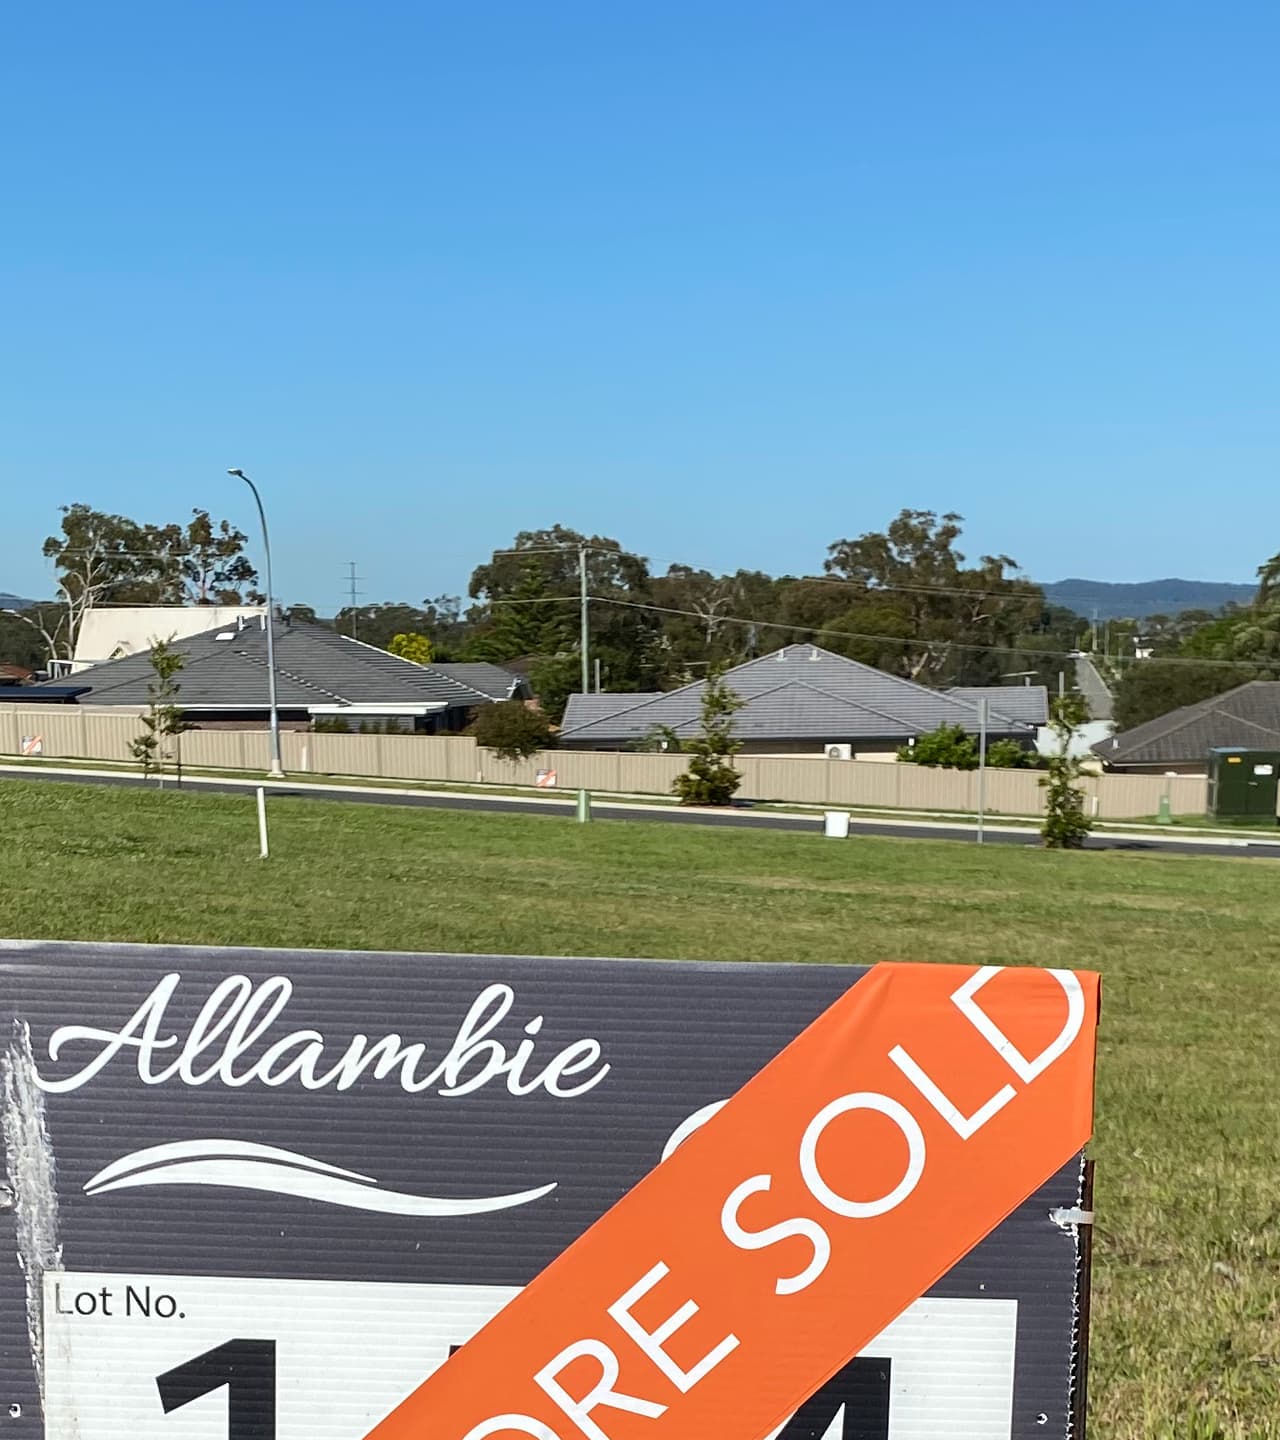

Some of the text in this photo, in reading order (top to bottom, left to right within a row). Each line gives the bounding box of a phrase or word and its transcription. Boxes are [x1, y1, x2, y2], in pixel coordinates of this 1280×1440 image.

[33, 972, 611, 1099] Allambie
[720, 965, 1086, 1295] SOLD
[54, 1282, 187, 1319] Lot No.
